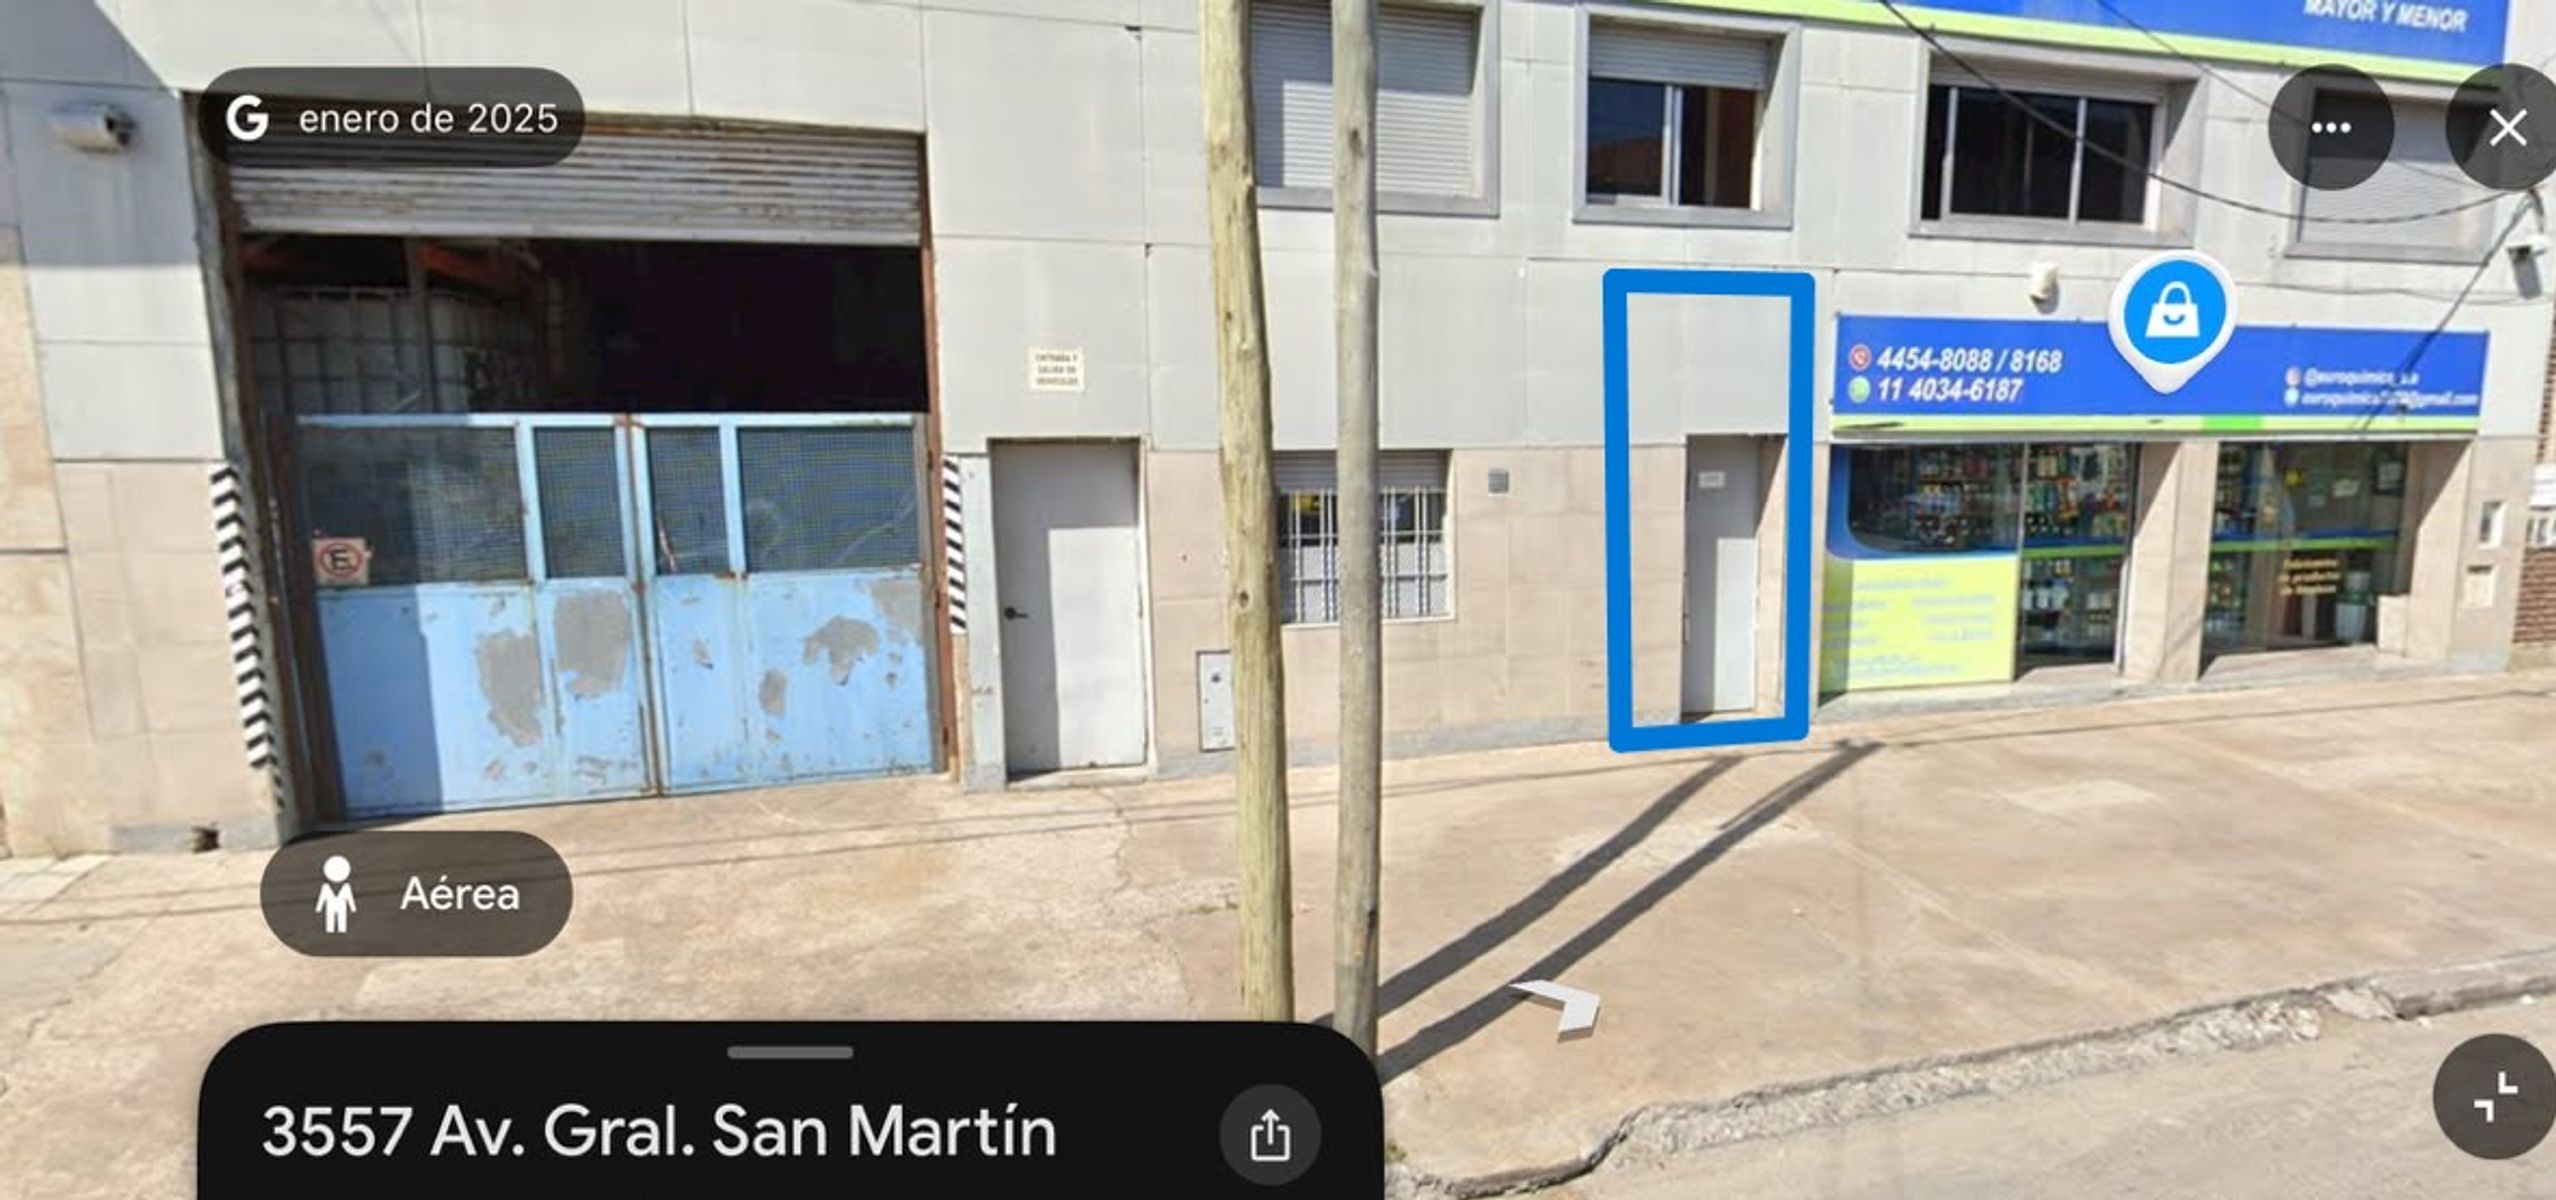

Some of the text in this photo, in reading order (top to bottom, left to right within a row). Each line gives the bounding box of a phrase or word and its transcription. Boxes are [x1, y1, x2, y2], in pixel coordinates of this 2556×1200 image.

[2303, 0, 2468, 33] MAYOR Y MENOR
[1876, 346, 1993, 372] 4454-8088
[2009, 348, 2063, 373] 8168
[1878, 377, 2024, 402] 11 4034-6187
[330, 549, 350, 570] E
